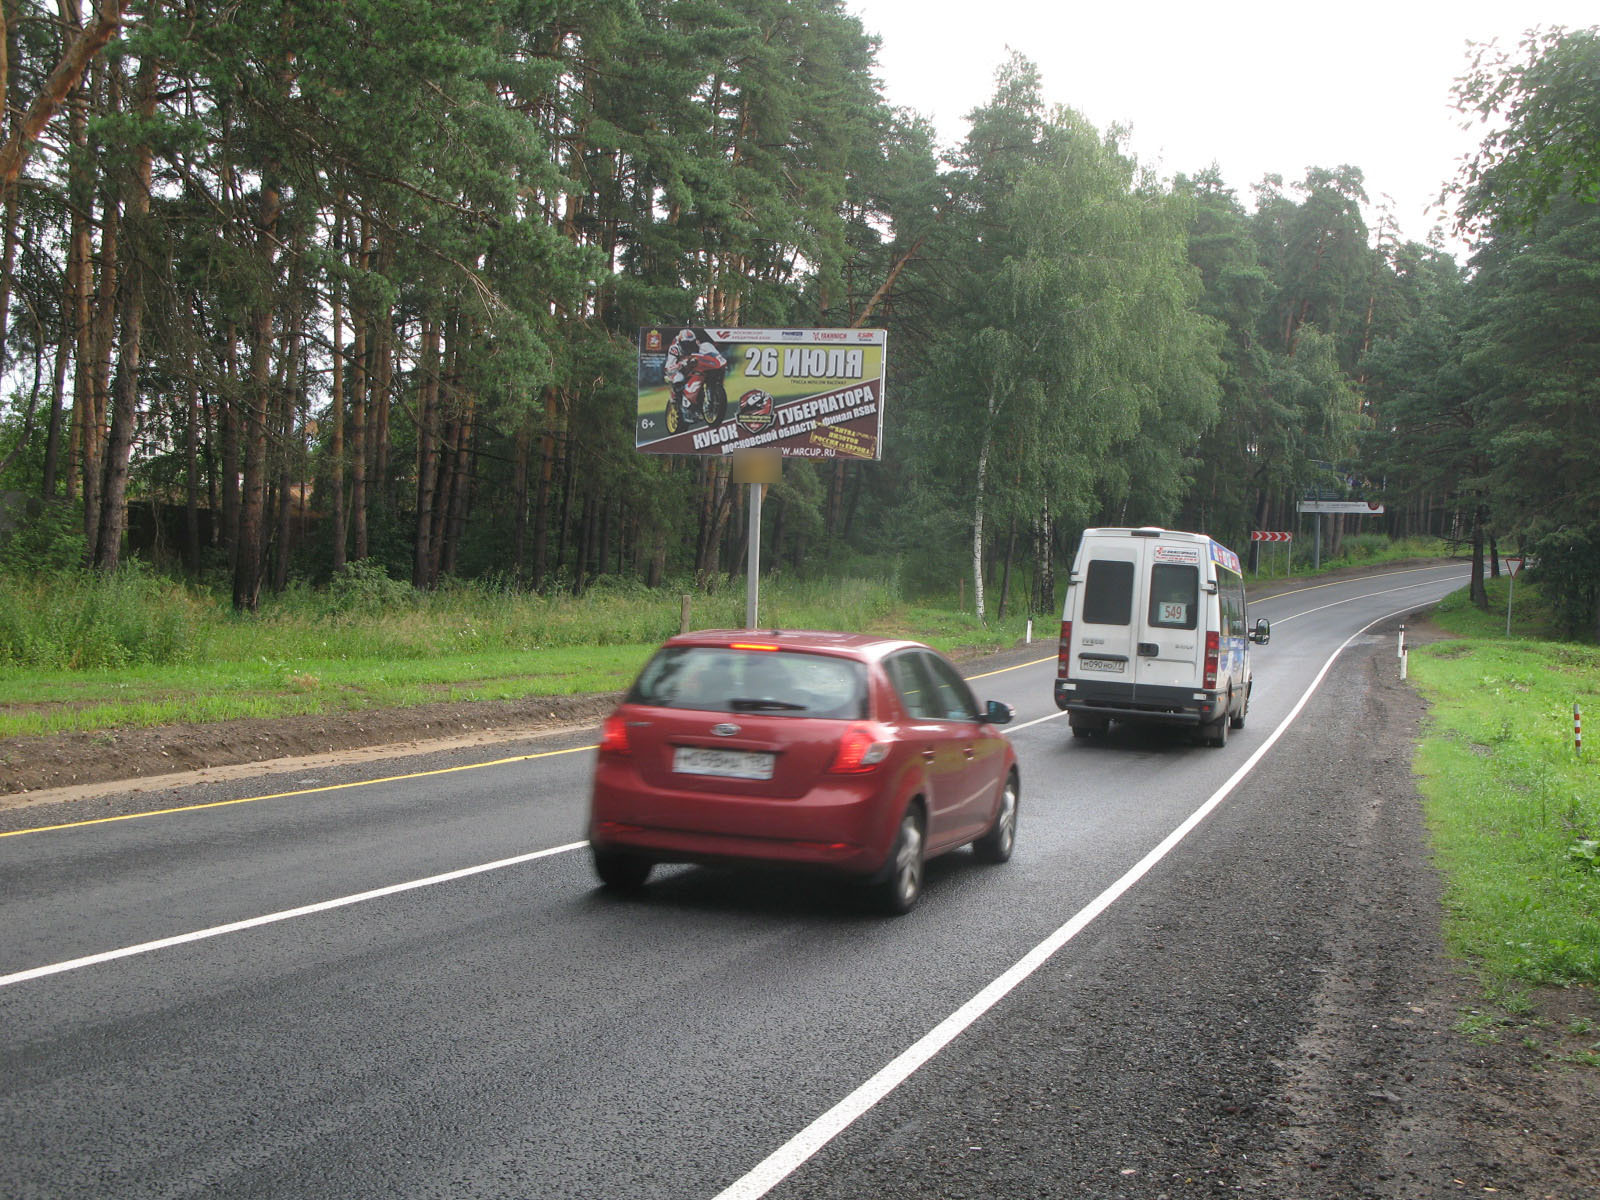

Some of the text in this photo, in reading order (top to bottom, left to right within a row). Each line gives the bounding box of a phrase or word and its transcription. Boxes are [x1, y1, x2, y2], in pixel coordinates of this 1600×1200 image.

[745, 348, 863, 378] 26 ИЮЛЯ
[641, 418, 655, 430] 6+
[693, 386, 874, 449] КУБОК ГУБЕРНАТОРА
[721, 430, 779, 454] МОСКОВСКОЙ
[778, 420, 817, 439] ОБЛАСТИ
[853, 404, 877, 418] RSBK
[1165, 605, 1182, 619] 549
